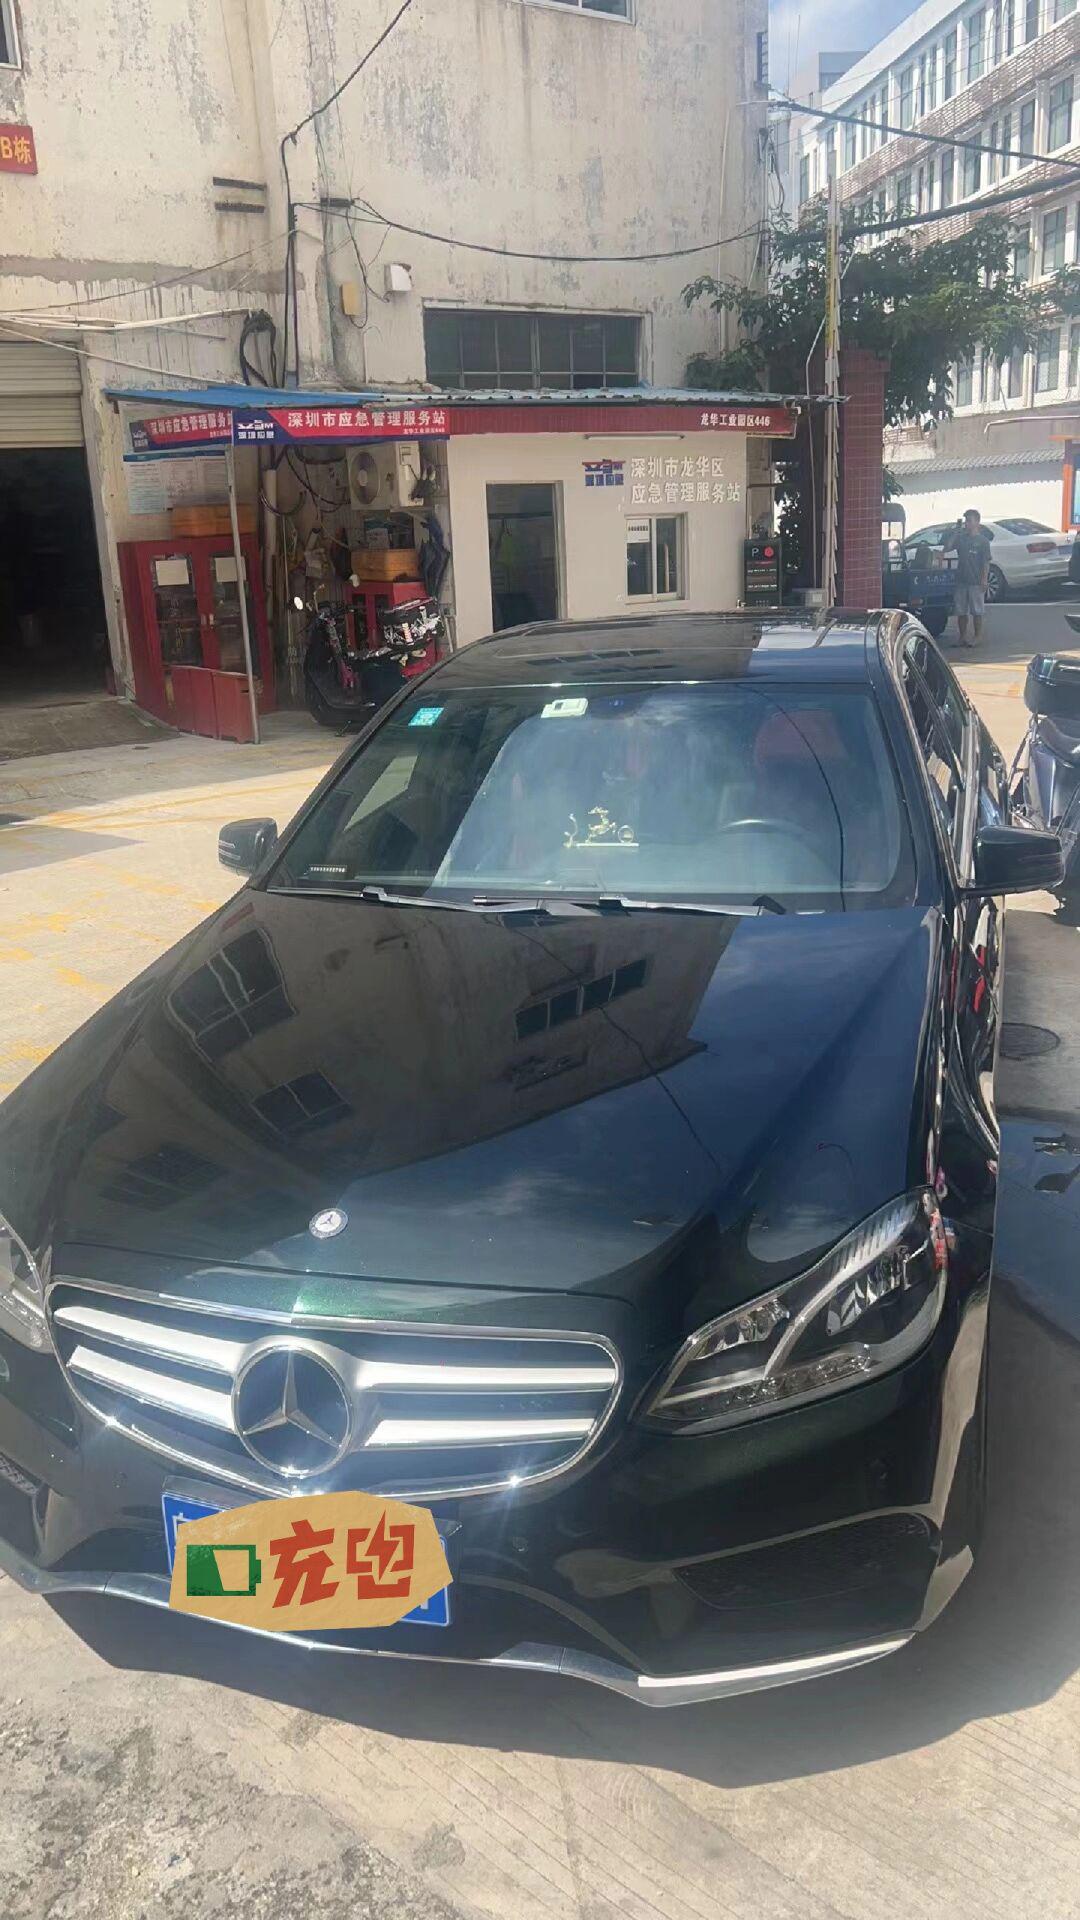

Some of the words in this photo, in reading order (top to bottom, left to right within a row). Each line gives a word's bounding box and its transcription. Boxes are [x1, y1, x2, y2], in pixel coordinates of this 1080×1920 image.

[0, 135, 32, 164] B栋
[287, 410, 445, 428] 深圳市应急管理服务站
[701, 413, 771, 427] 龙华工业园区446
[631, 456, 724, 478] 深圳市龙华区
[631, 482, 741, 504] 应急管理服务站
